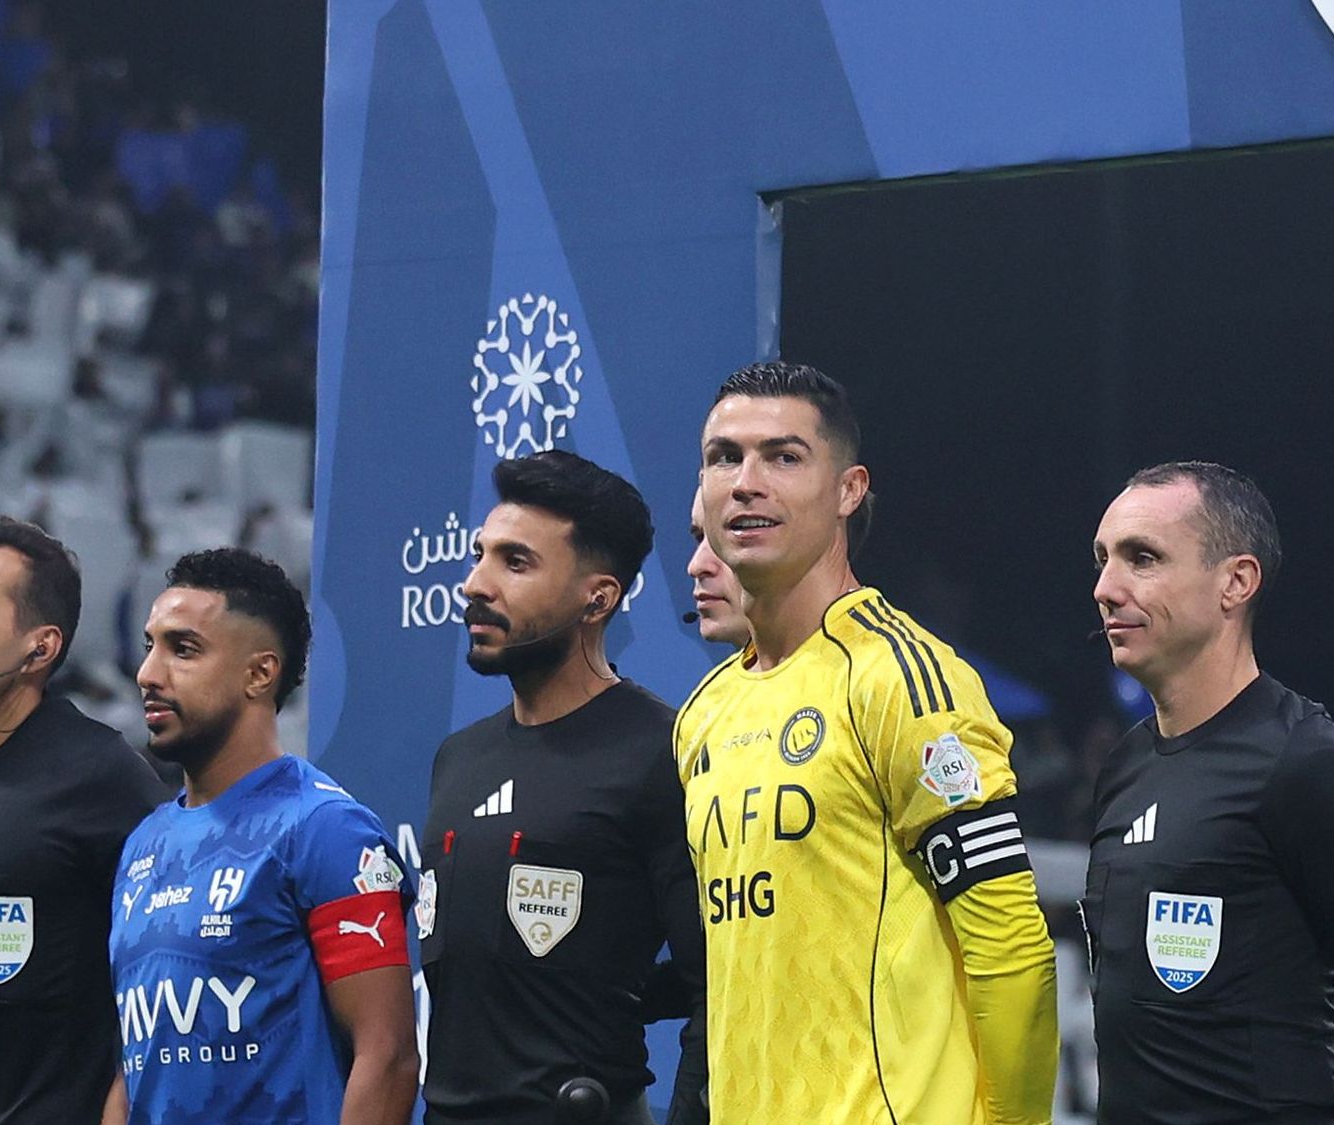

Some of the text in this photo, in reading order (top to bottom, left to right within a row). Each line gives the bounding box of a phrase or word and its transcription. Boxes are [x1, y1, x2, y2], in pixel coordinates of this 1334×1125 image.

[401, 582, 468, 628] ROS
[942, 760, 966, 777] RSL
[687, 785, 816, 854] AFD
[926, 833, 959, 885] C
[516, 877, 576, 901] SAFF
[708, 871, 775, 925] SHG
[519, 902, 568, 917] REFEREE
[1154, 899, 1214, 926] FIFA
[1153, 934, 1212, 947] ASSISTANT
[1157, 946, 1207, 959] REFEREE
[1166, 970, 1194, 983] 2025
[160, 1043, 259, 1064] GROUP
